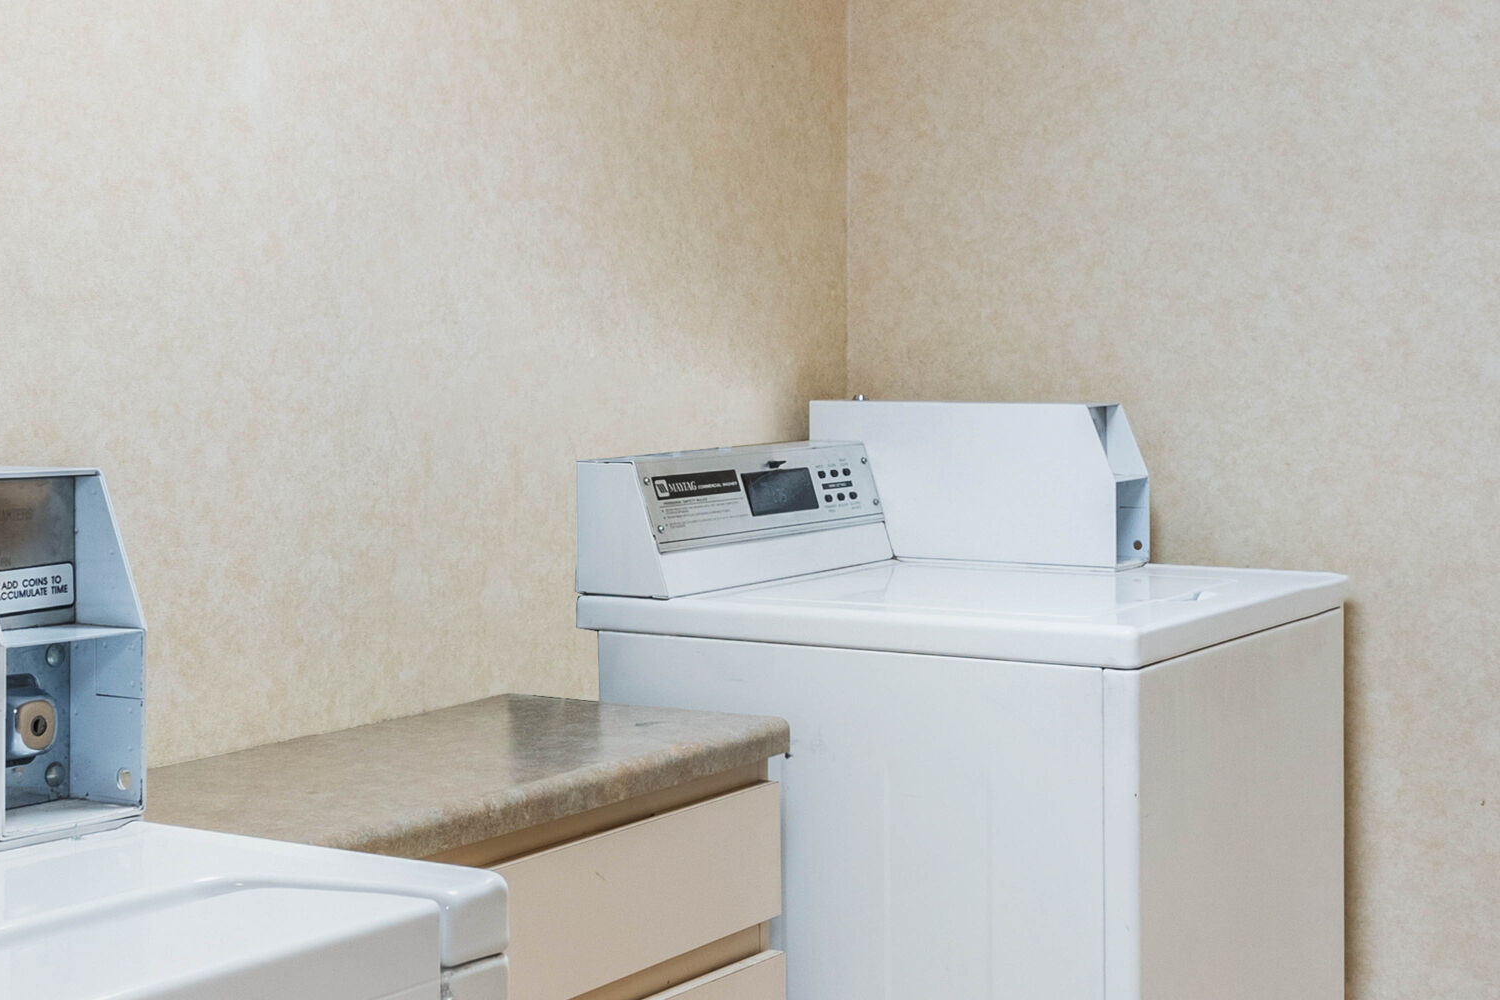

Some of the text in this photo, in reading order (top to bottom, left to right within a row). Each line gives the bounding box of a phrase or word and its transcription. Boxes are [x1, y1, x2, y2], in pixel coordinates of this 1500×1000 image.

[668, 481, 697, 493] MAYTAG
[1, 575, 62, 591] ADD COINS TO
[51, 584, 69, 595] TIME
